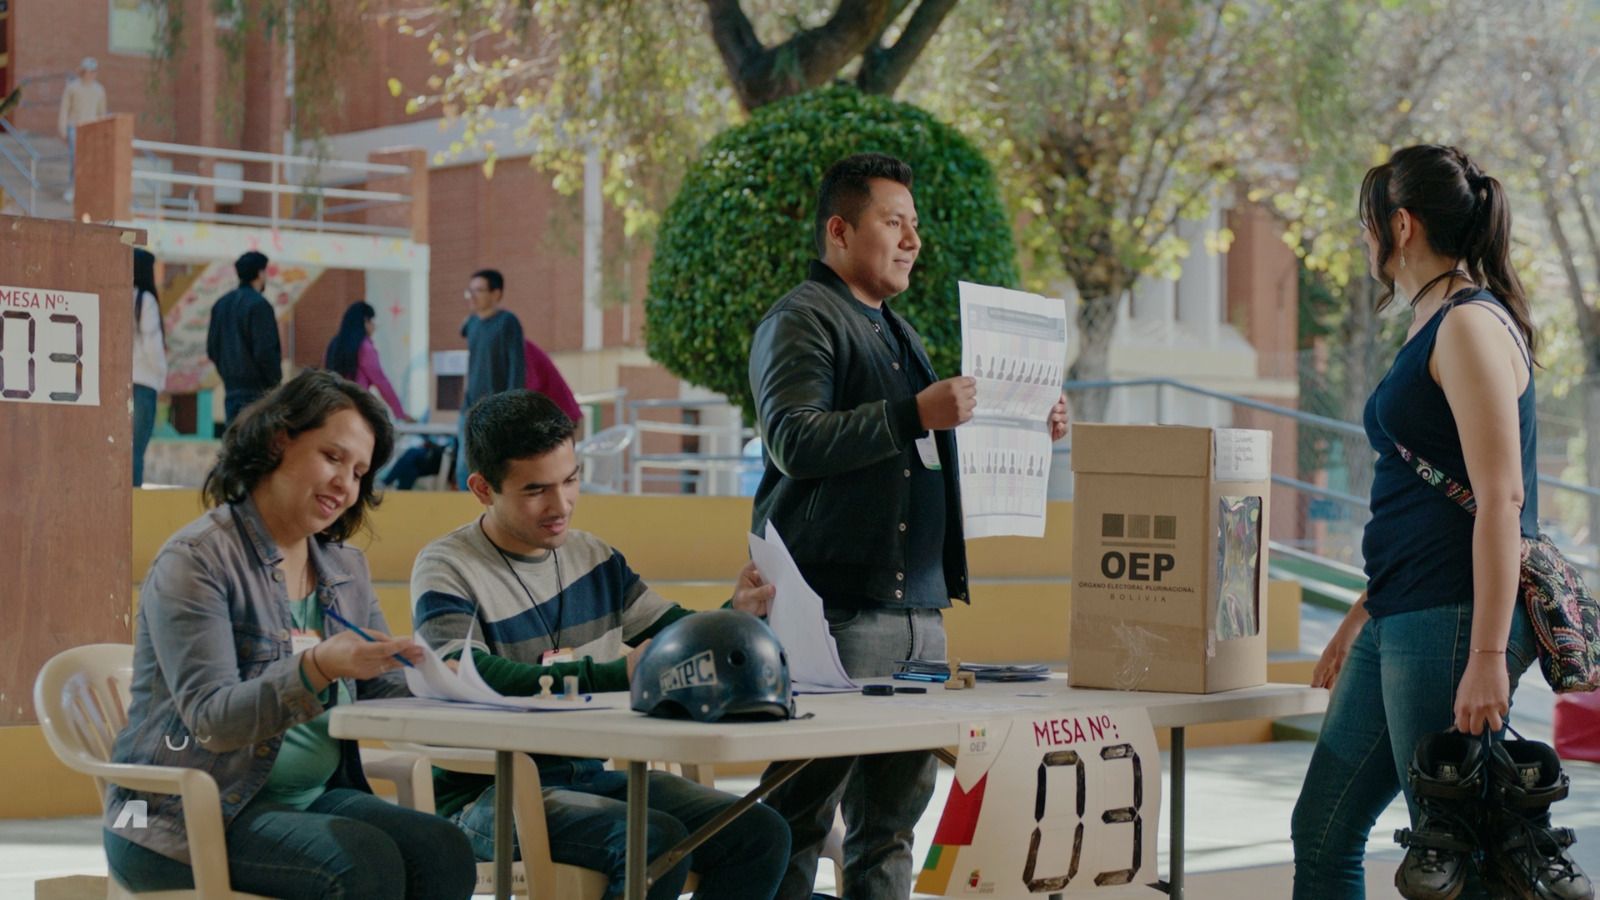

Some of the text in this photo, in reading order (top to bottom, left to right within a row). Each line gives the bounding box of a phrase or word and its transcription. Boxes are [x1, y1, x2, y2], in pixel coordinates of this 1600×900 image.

[0, 290, 40, 309] MESA
[0, 310, 83, 402] 03
[1101, 551, 1175, 582] OEP
[1107, 583, 1143, 591] ELECTORAL
[1146, 585, 1194, 593] PLURINACIONAL
[1110, 593, 1166, 603] BOLIVIA
[1033, 718, 1086, 747] MESA
[970, 741, 987, 752] OEP
[1022, 743, 1142, 894] 03
